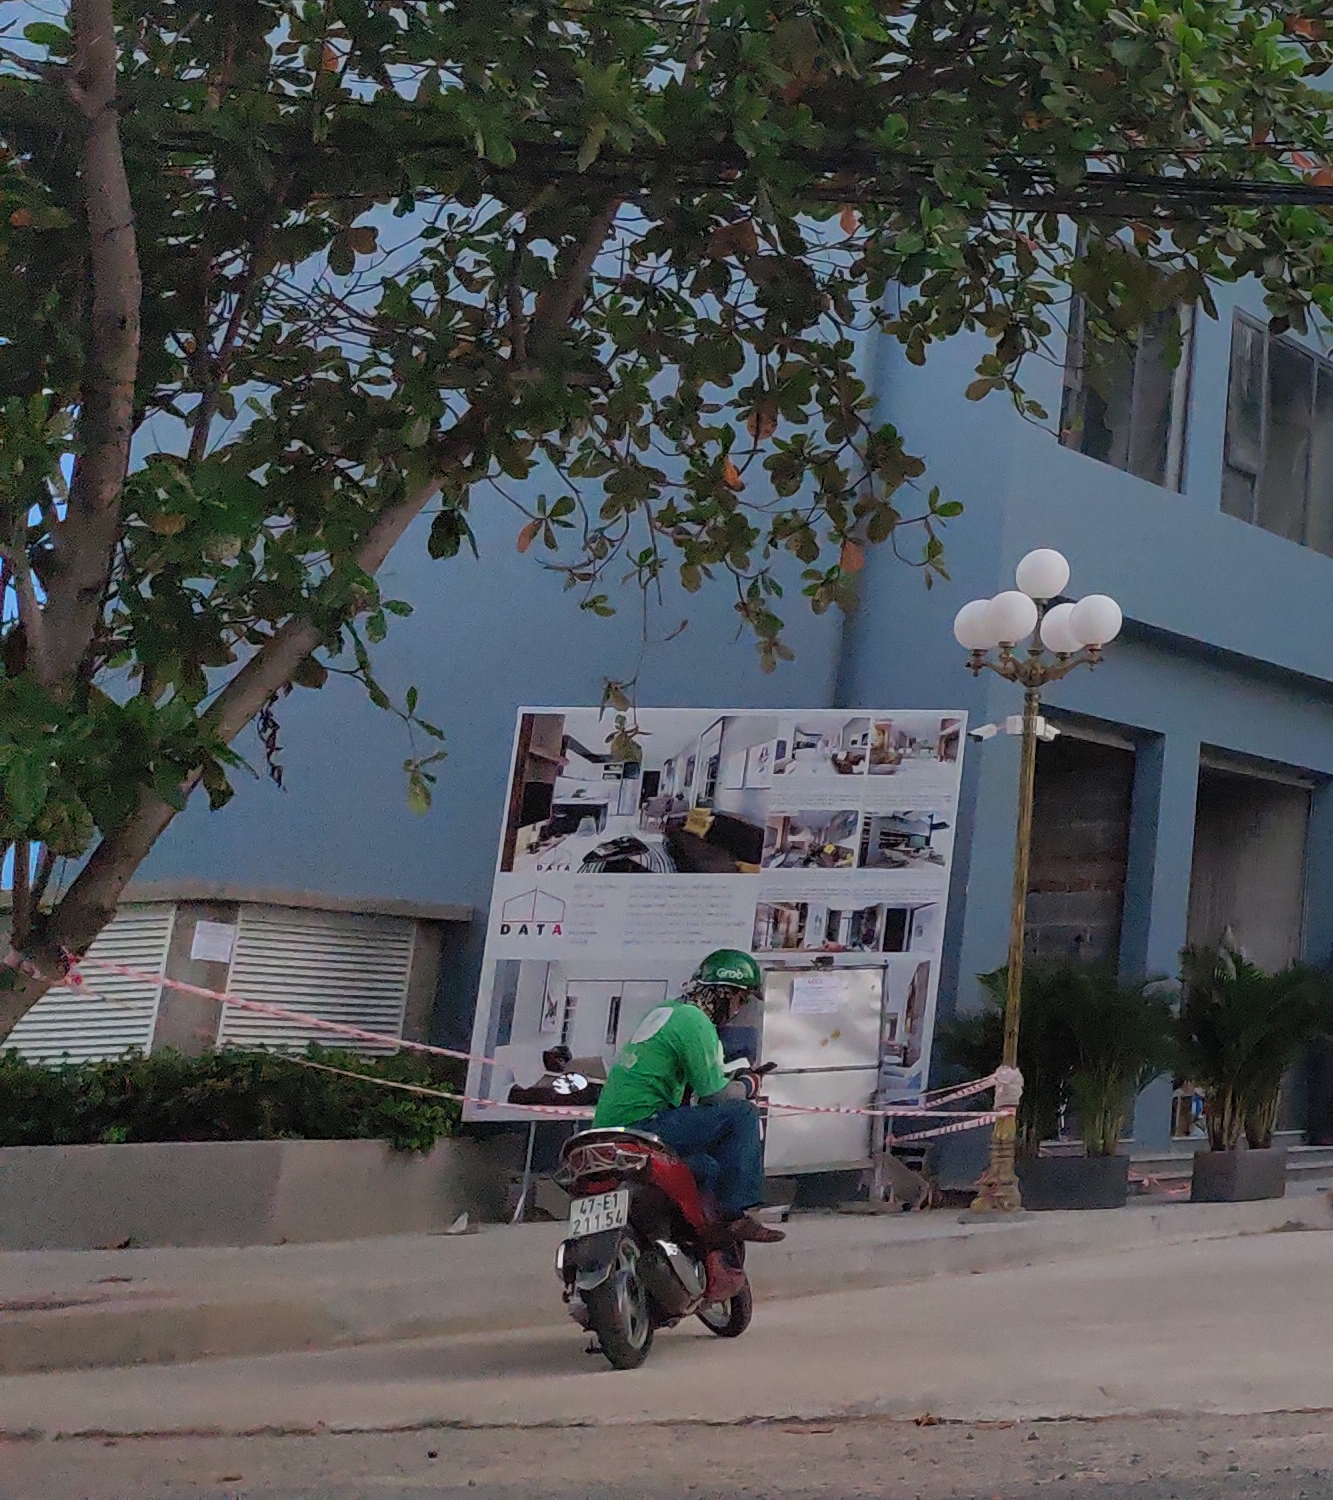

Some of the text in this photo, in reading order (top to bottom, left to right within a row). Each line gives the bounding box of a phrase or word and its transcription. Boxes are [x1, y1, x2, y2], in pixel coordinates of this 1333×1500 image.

[537, 863, 571, 871] DATA
[500, 923, 563, 936] DATA
[716, 967, 743, 980] Grab
